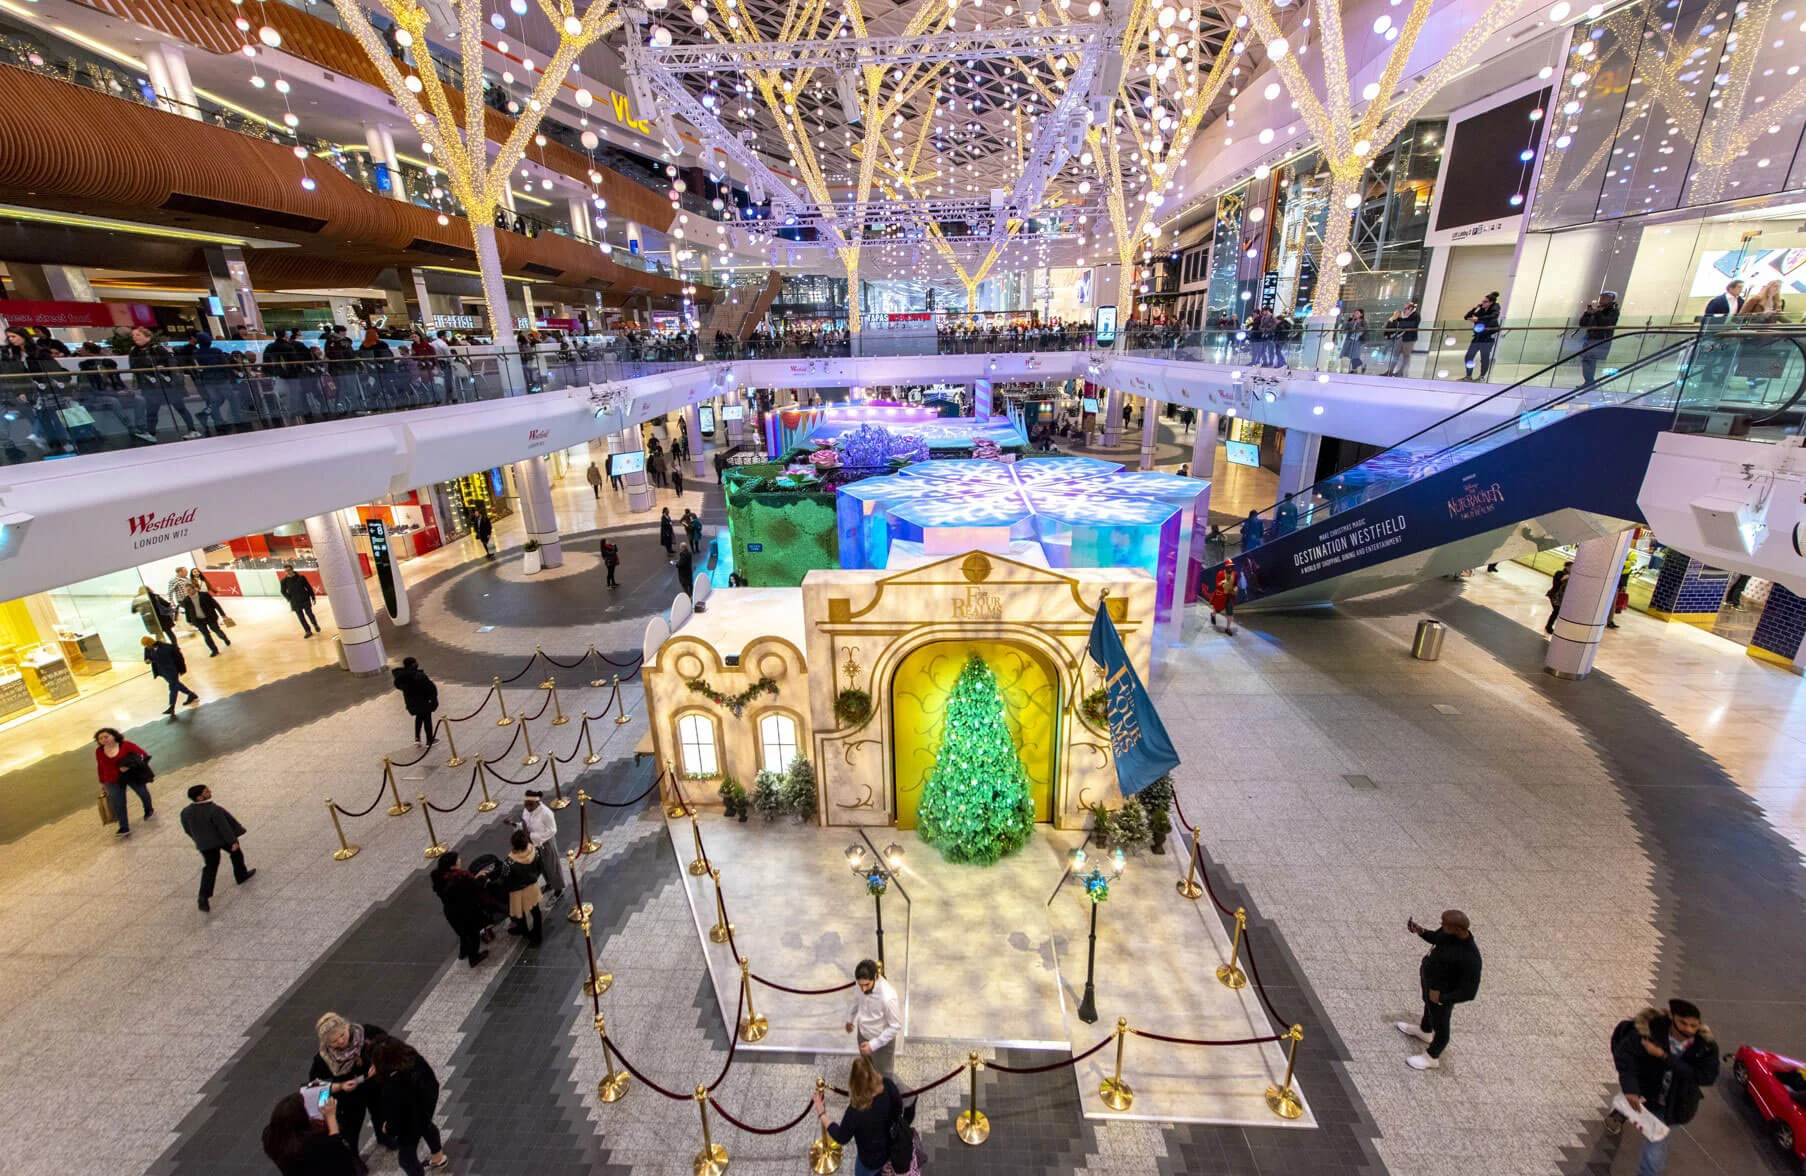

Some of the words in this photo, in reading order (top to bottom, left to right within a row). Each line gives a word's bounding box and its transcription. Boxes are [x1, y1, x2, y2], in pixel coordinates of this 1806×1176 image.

[867, 313, 888, 323] TAPAS
[127, 507, 199, 536] Westfield
[377, 527, 384, 536] 8
[1329, 523, 1352, 539] CHRISTMAS
[134, 533, 170, 549] LONDON
[173, 528, 188, 539] W12
[1293, 538, 1348, 566] DESTINATION
[1349, 515, 1406, 547] WESTFIELD
[952, 598, 1002, 620] REALMS
[965, 586, 1002, 610] FOUR
[1106, 661, 1143, 748] FOUR
